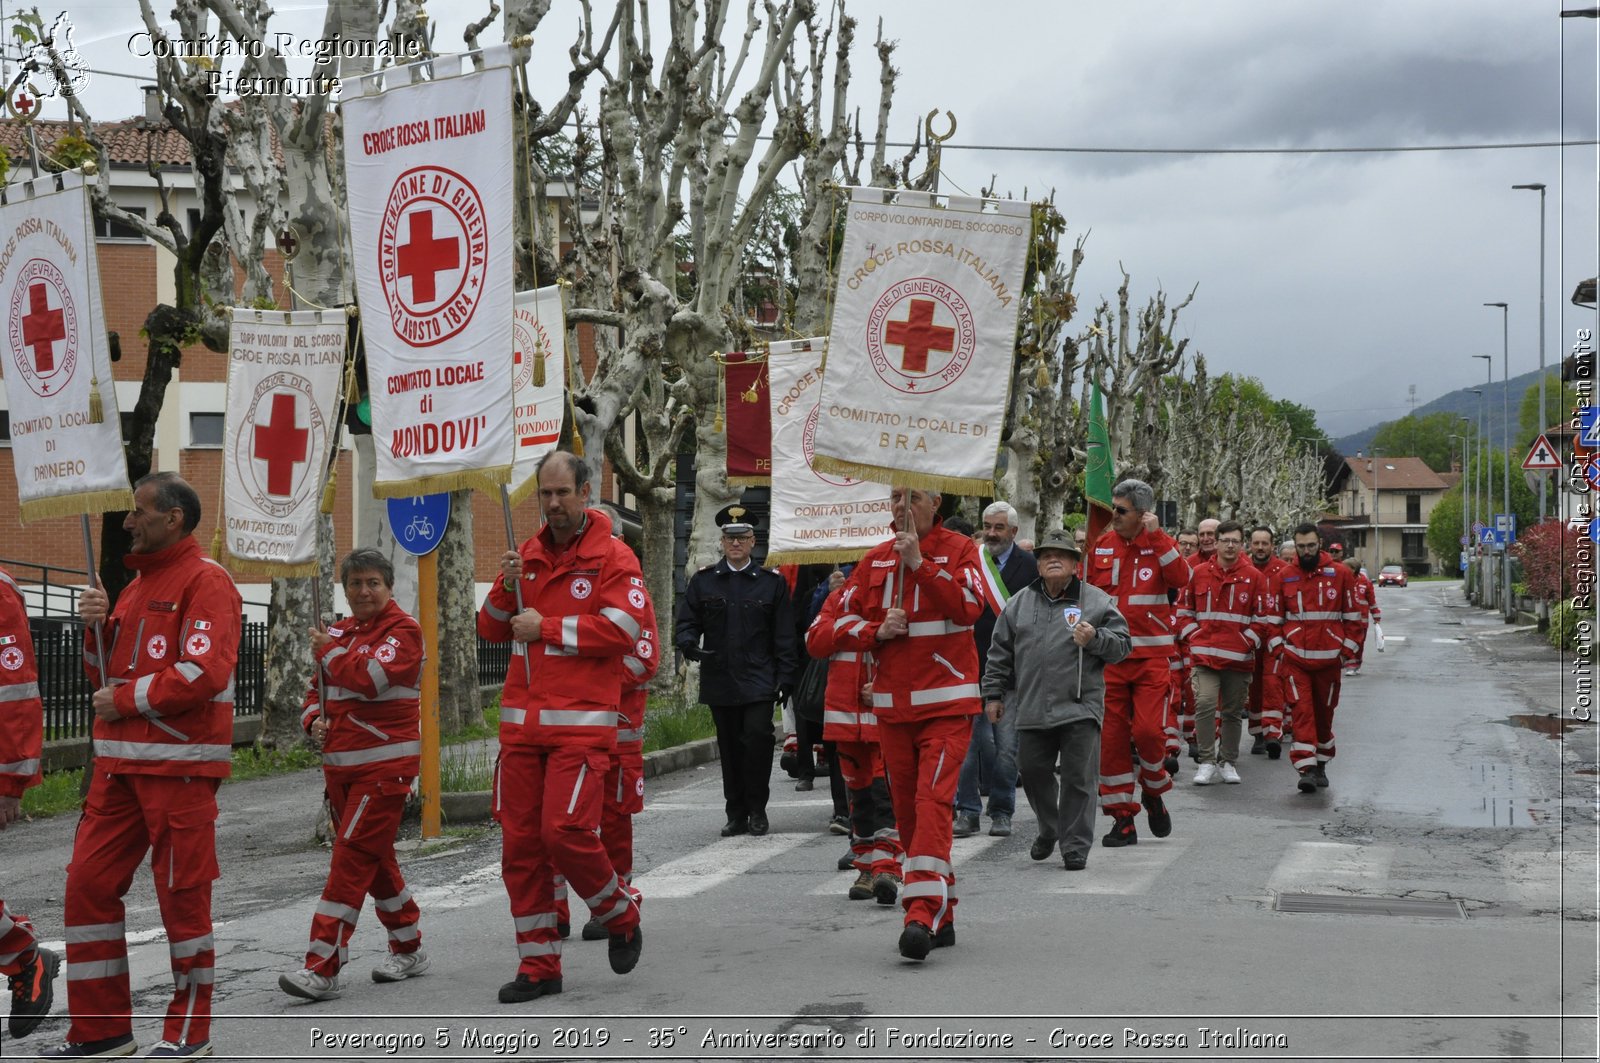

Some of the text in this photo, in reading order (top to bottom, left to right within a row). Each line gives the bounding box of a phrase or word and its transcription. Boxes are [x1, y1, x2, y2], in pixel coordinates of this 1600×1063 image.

[362, 109, 486, 156] CROCE ROSSA ITALIANA
[383, 174, 484, 283] CONVENZIONE DI GINEVRA
[854, 211, 1023, 236] CORPO VOLONTARI DEL SOCCORSO
[16, 218, 43, 242] ROSSA
[46, 220, 77, 268] ITALIANA
[846, 240, 1012, 308] CRCE ROSSA ITALIANA
[392, 293, 472, 341] 22 AGOSTO 1864
[10, 290, 32, 380] CONVENZIONE
[63, 348, 75, 374] 1864
[294, 335, 308, 348] DEL
[870, 282, 973, 382] CONVENZIONE DI GINEVRA 22 AGOSTO 1864
[290, 376, 302, 388] DI
[388, 362, 484, 394] COMITATO LOCALE
[420, 394, 432, 414] di
[776, 370, 816, 416] CROCE
[12, 411, 90, 436] COMITATO LOCAL
[526, 404, 537, 416] DI
[829, 404, 988, 438] COMITATO LOCALE DI
[46, 440, 56, 452] DI
[391, 416, 486, 458] MONDOVI'
[794, 501, 892, 517] COMITATO LOCAL
[842, 517, 852, 526] DI
[276, 523, 298, 536] LOCAL
[794, 526, 891, 540] LIMONE PIEMONT
